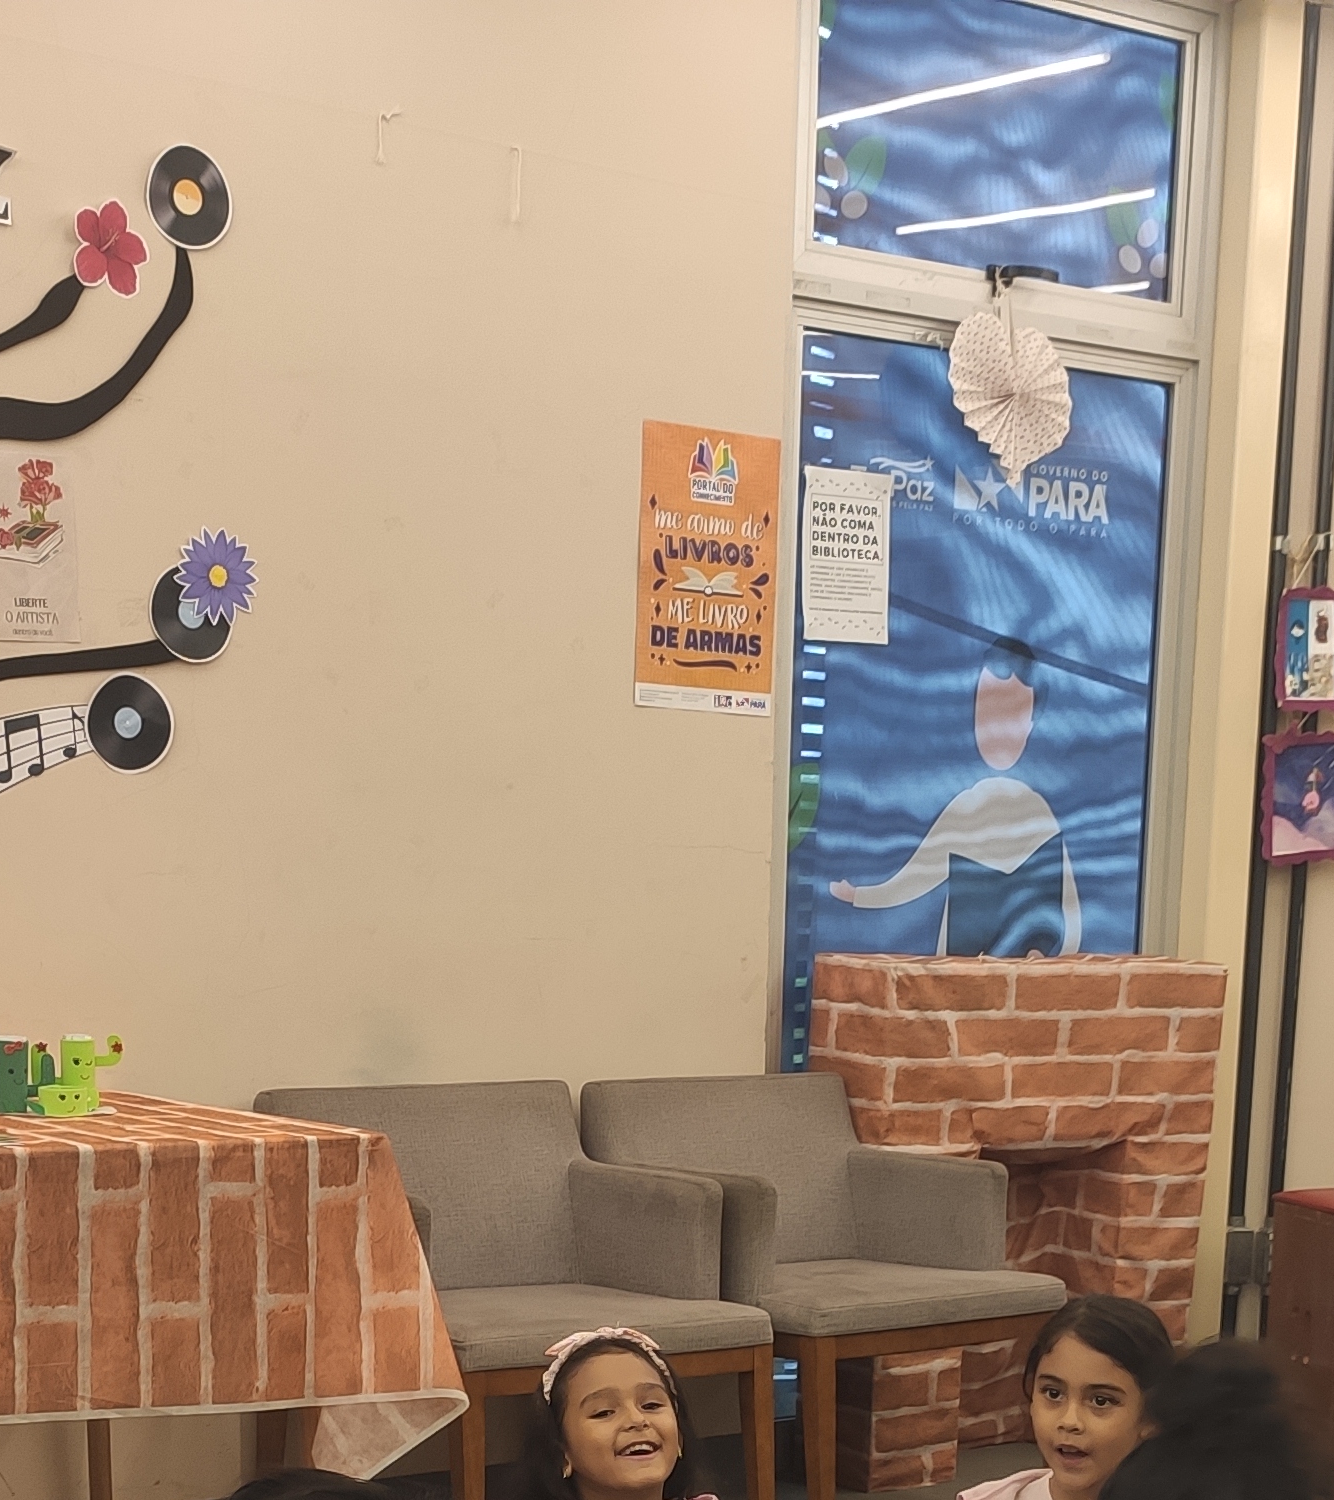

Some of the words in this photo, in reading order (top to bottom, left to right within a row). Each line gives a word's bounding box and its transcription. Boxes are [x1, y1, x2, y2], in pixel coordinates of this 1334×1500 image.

[1030, 464, 1088, 480] GOVERNO
[1092, 469, 1109, 482] DO
[692, 479, 721, 492] PORTAL
[722, 483, 734, 494] DO
[812, 500, 836, 514] POR
[655, 509, 682, 529] me
[687, 513, 735, 537] como
[741, 513, 765, 540] de
[812, 512, 838, 528] NÃO
[840, 517, 875, 532] COMA
[953, 513, 983, 526] POR
[994, 516, 1039, 533] TODO
[1049, 522, 1059, 534] O
[812, 530, 860, 545] DENTRO
[862, 534, 879, 547] DA
[664, 534, 756, 568] LIVROS
[14, 597, 49, 609] LIBERTE
[5, 610, 14, 623] O
[15, 611, 60, 625] ARTISTA
[668, 597, 695, 624] ME
[699, 599, 750, 630] LIVRO
[650, 624, 680, 649] DE
[684, 628, 762, 658] ARMAS
